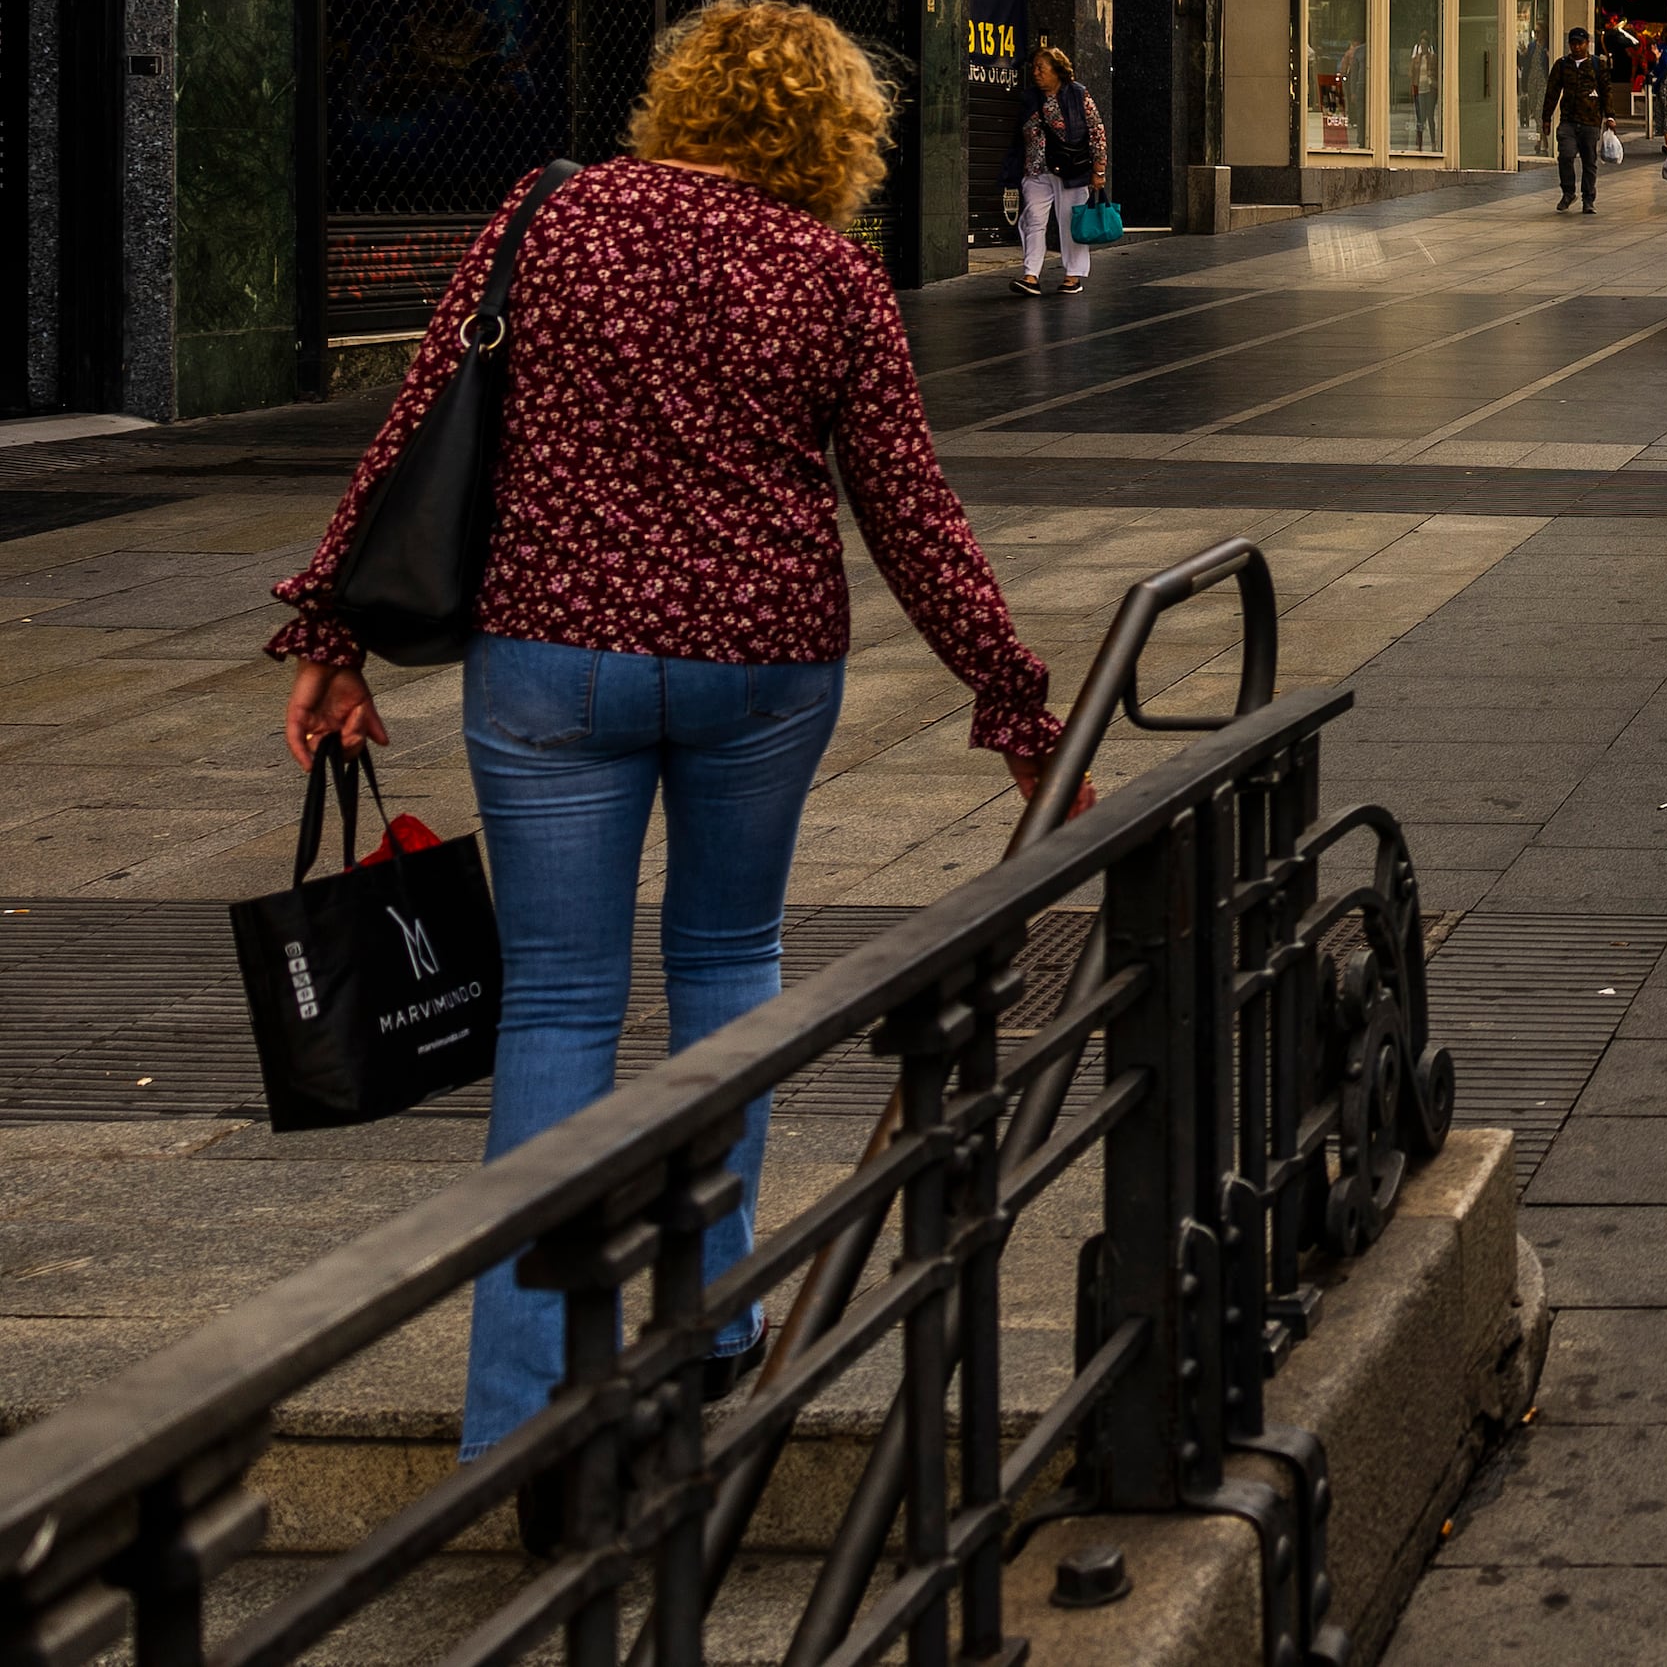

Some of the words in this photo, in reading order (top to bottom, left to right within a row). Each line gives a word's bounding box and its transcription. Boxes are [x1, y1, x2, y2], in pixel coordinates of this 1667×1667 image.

[977, 21, 996, 56] 13
[997, 24, 1015, 58] 14
[378, 980, 483, 1035] MARVIMUNDO
